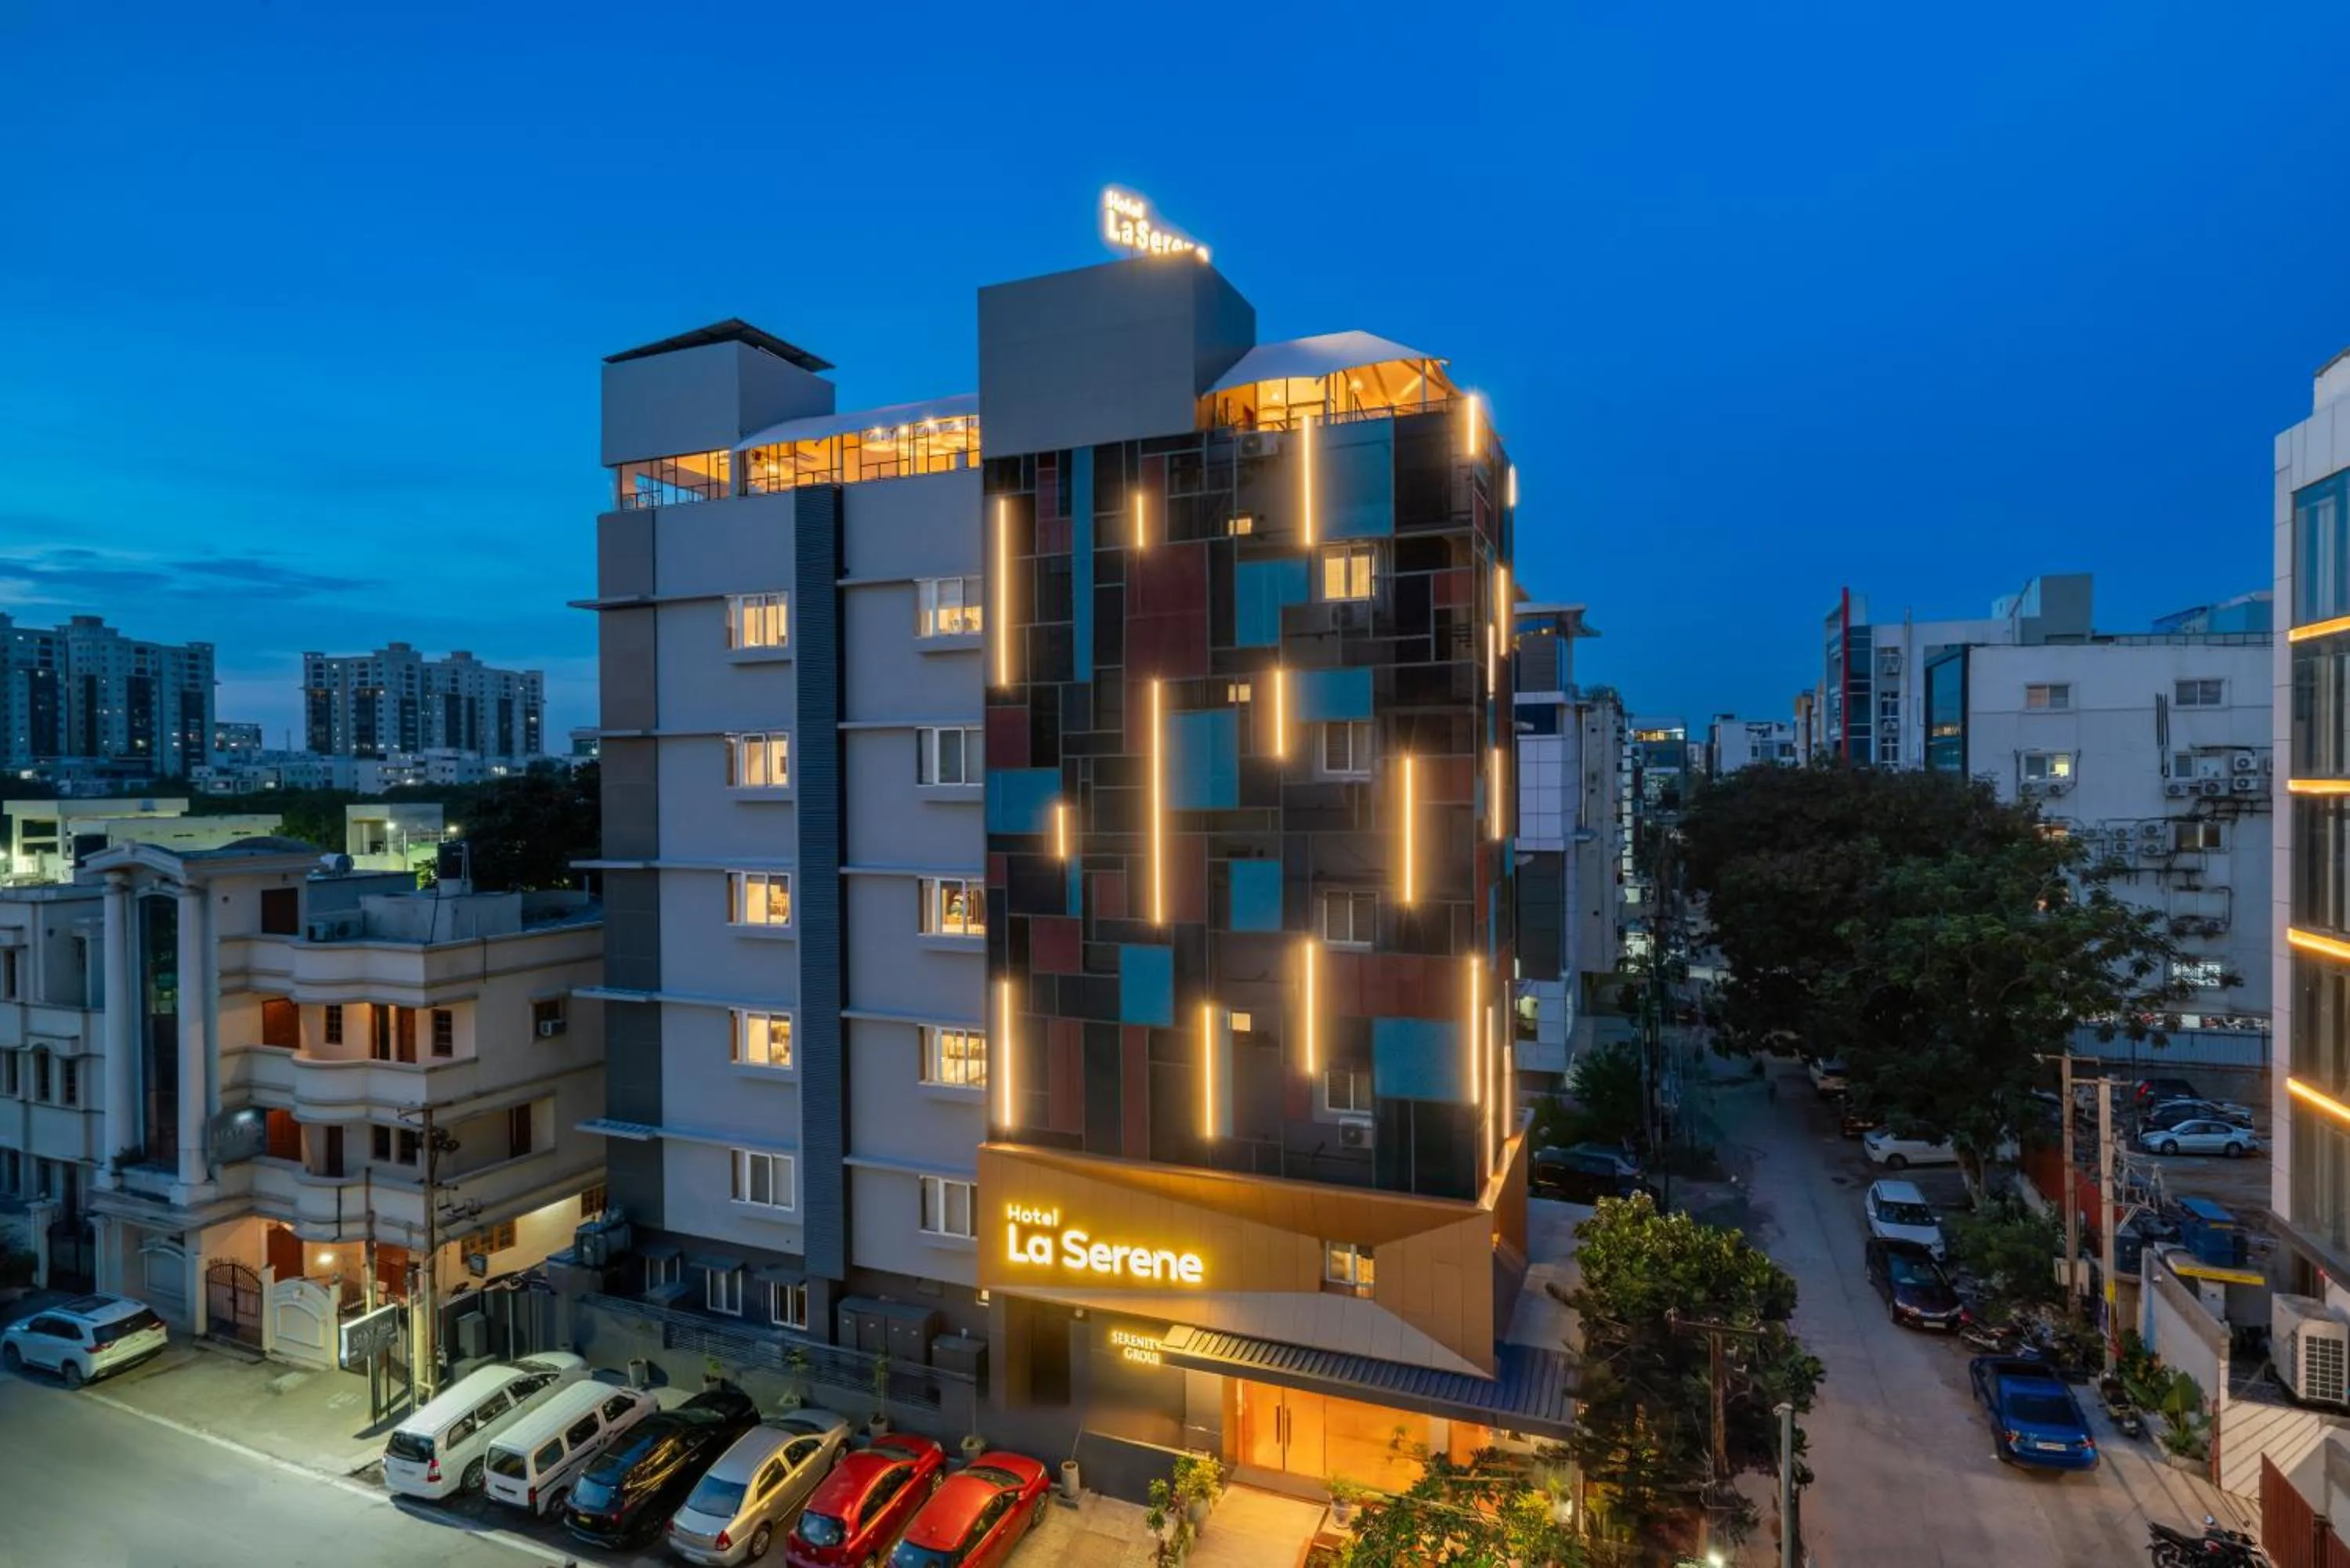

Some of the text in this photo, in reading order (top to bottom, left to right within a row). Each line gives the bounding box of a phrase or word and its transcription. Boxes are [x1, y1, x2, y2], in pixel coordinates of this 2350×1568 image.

[1105, 208, 1133, 244] La
[1007, 1203, 1058, 1227] Hotel
[1007, 1223, 1204, 1284] La Serene
